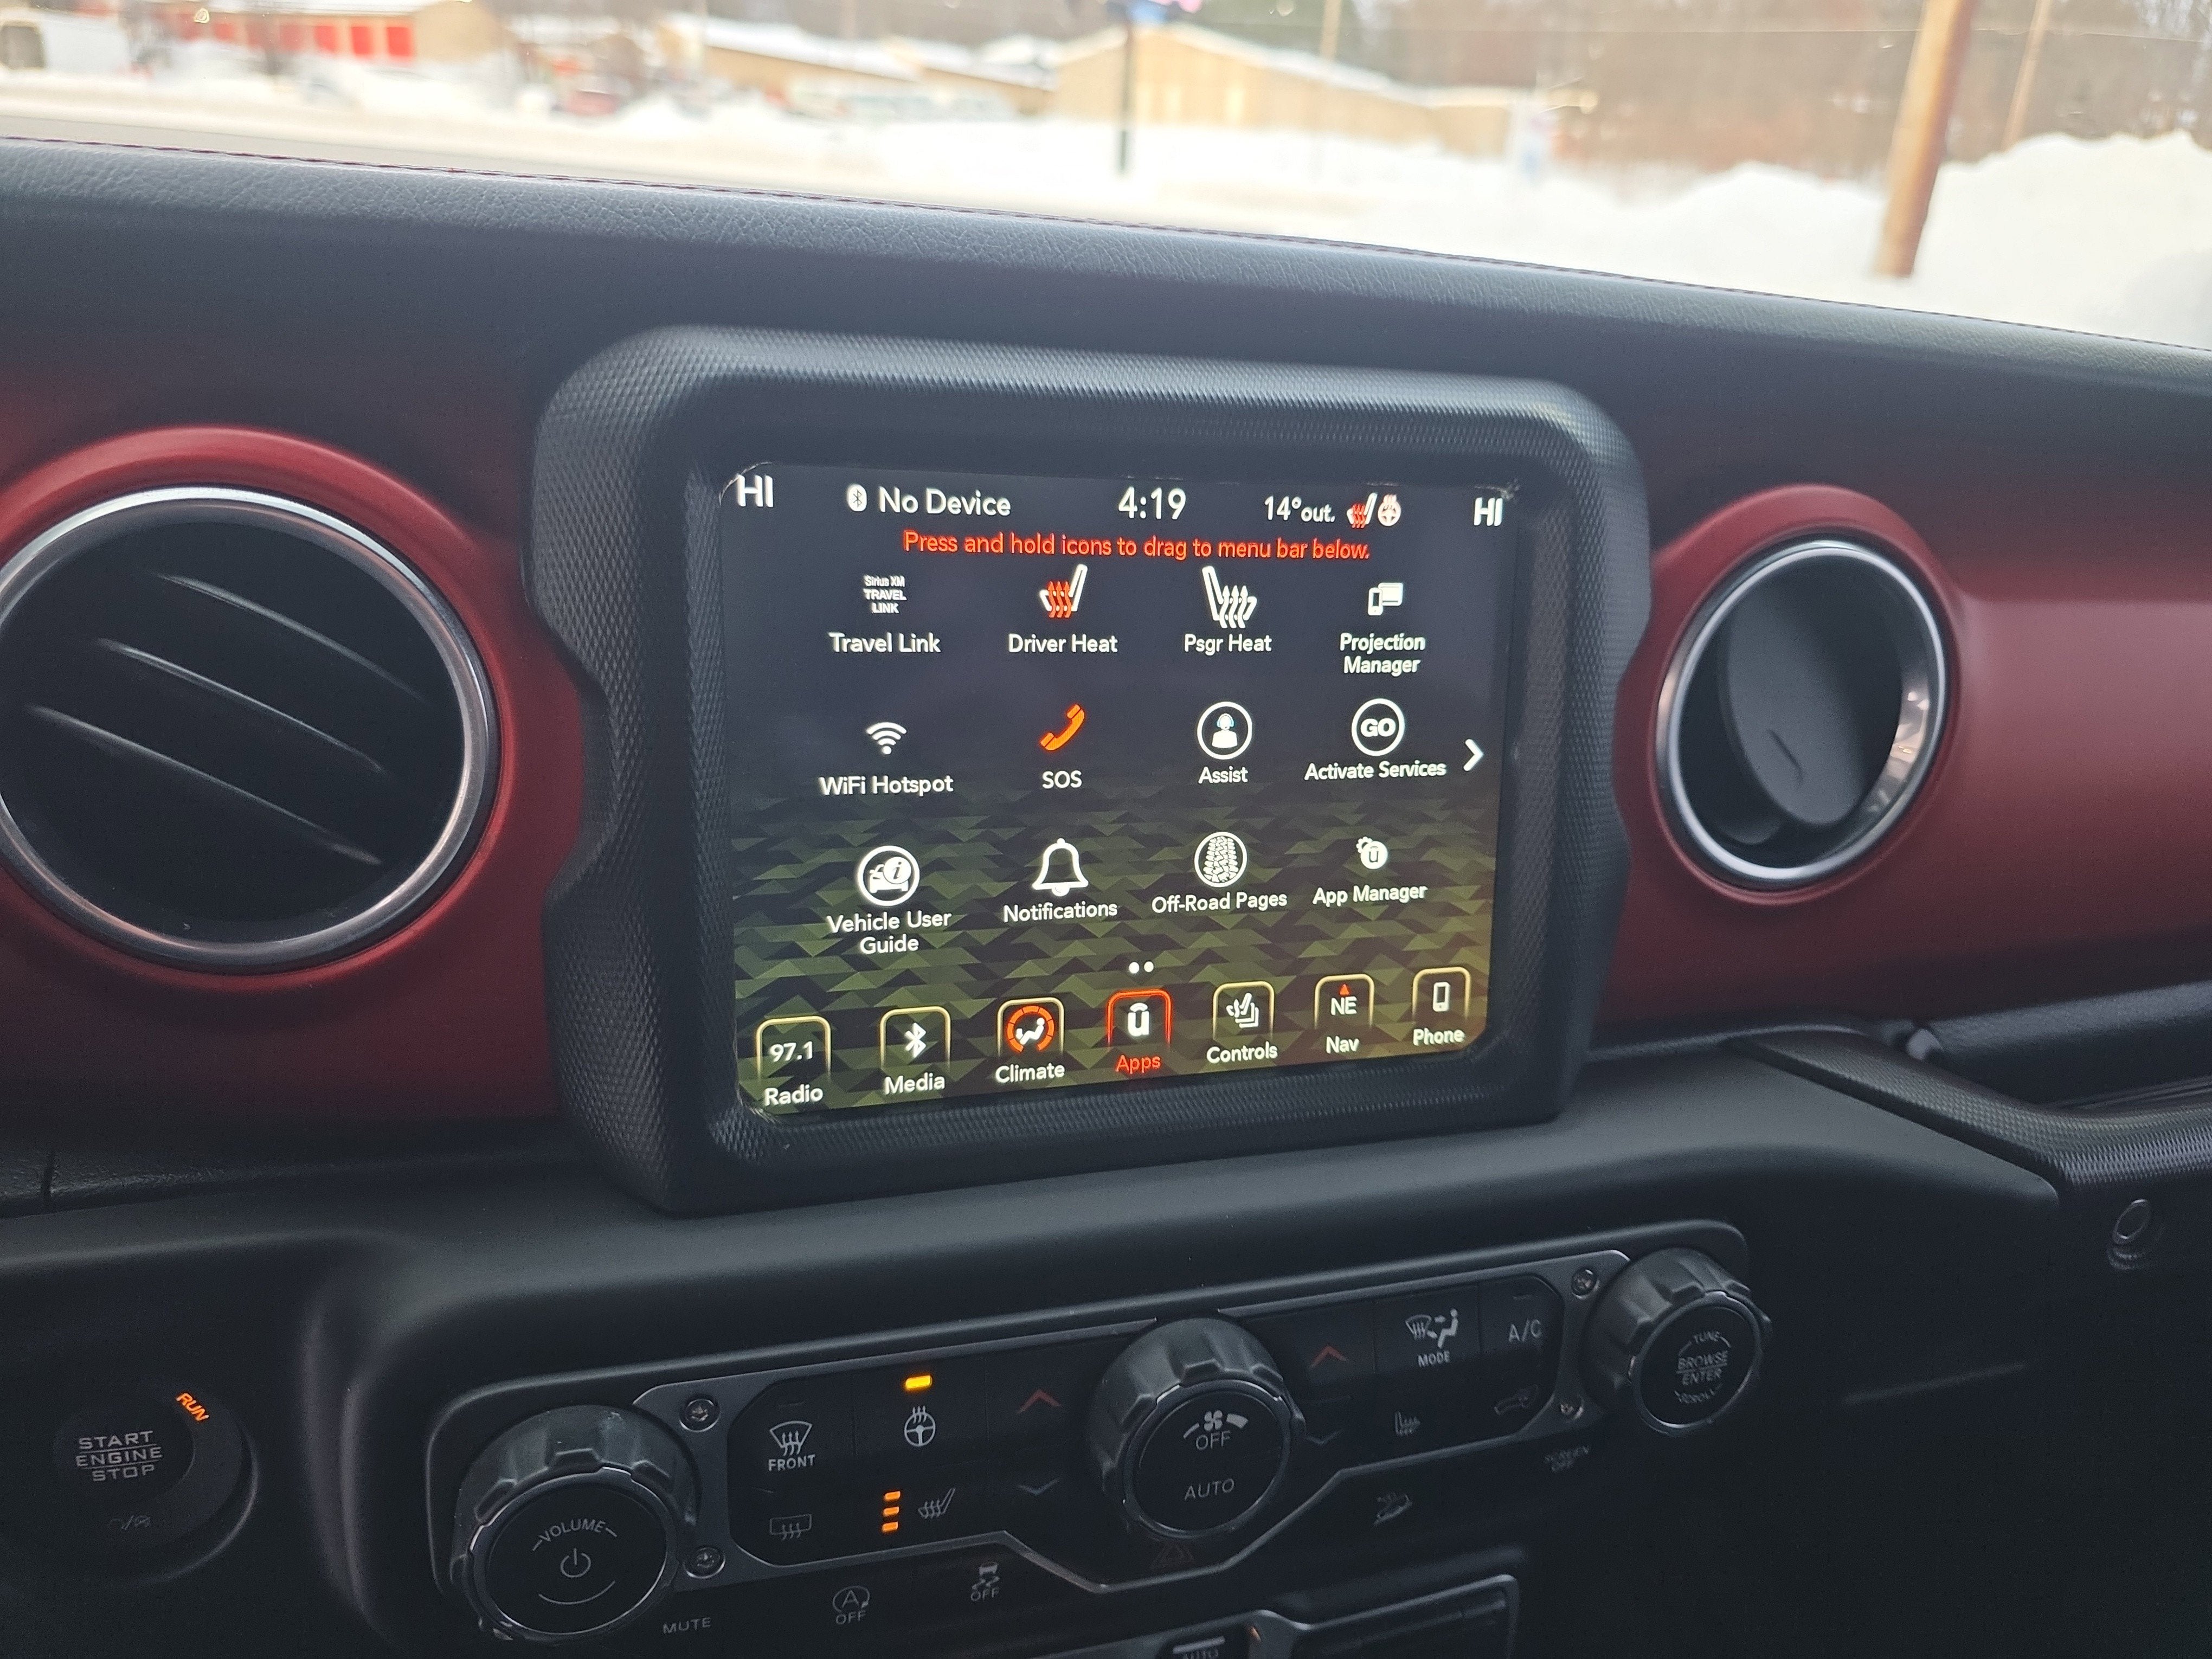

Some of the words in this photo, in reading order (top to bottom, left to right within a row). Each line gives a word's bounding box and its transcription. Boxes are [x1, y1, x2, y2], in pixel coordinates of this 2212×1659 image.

[737, 474, 774, 508] HI
[879, 487, 918, 513] No
[926, 489, 1012, 516] Device
[1118, 487, 1186, 520] 4:19
[1474, 497, 1503, 526] HI
[904, 530, 958, 554] Press
[964, 533, 1004, 554] and
[1011, 533, 1055, 555] hold
[1062, 535, 1112, 556] icons
[1117, 537, 1137, 556] to
[1144, 536, 1186, 561] drag
[1193, 538, 1212, 557] to
[1218, 542, 1271, 558] menu
[1277, 538, 1307, 559] bar
[1313, 539, 1371, 560] below.
[864, 575, 889, 588] Sirius
[891, 576, 905, 588] XM
[864, 588, 906, 601] TRAVEL
[872, 602, 899, 614] LINK
[828, 632, 893, 652] Travel
[898, 633, 941, 653] Link
[1008, 634, 1066, 652] Driver
[1072, 634, 1118, 652] Heat
[1185, 634, 1223, 655] Psgr
[1228, 634, 1272, 652] Heat
[1339, 633, 1425, 655] Projection
[1343, 657, 1420, 677] Manager
[1360, 718, 1396, 737] GO
[1042, 770, 1082, 789] SOS
[1198, 766, 1248, 783] Assist
[1304, 762, 1374, 781] Activate
[1378, 760, 1447, 778] Services
[819, 776, 866, 795] WiFi
[872, 775, 954, 796] Hotspot
[1152, 893, 1231, 914] Off-Road
[1236, 892, 1288, 913] Pages
[1312, 886, 1348, 906] App
[1353, 884, 1428, 904] Manager
[827, 912, 901, 934] Vehicle
[907, 910, 951, 929] User
[1003, 901, 1118, 922] Notifications
[860, 936, 919, 955] Guide
[1330, 996, 1356, 1015] NE
[1326, 1036, 1359, 1054] Nav
[1412, 1027, 1465, 1047] Phone
[770, 1041, 813, 1063] 97.1
[1206, 1041, 1278, 1064] Controls
[995, 1062, 1065, 1083] Climate
[1115, 1054, 1161, 1073] Apps
[884, 1072, 946, 1095] Media
[764, 1084, 824, 1107] Radio
[1508, 1319, 1541, 1343] A/C
[1418, 1350, 1450, 1367] MODE
[1678, 1350, 1728, 1370] BROWSE
[1682, 1368, 1722, 1385] ENTER
[176, 1393, 209, 1421] RUN
[78, 1430, 153, 1450] START
[1195, 1431, 1231, 1451] OFF
[75, 1446, 162, 1467] ENGINE
[768, 1454, 815, 1472] FRONT
[92, 1464, 155, 1482] STOP
[1184, 1478, 1236, 1501] AUTO
[540, 1519, 605, 1542] VOLUME
[970, 1587, 1000, 1602] OFF
[663, 1617, 712, 1634] MUTE
[835, 1610, 867, 1625] OFF
